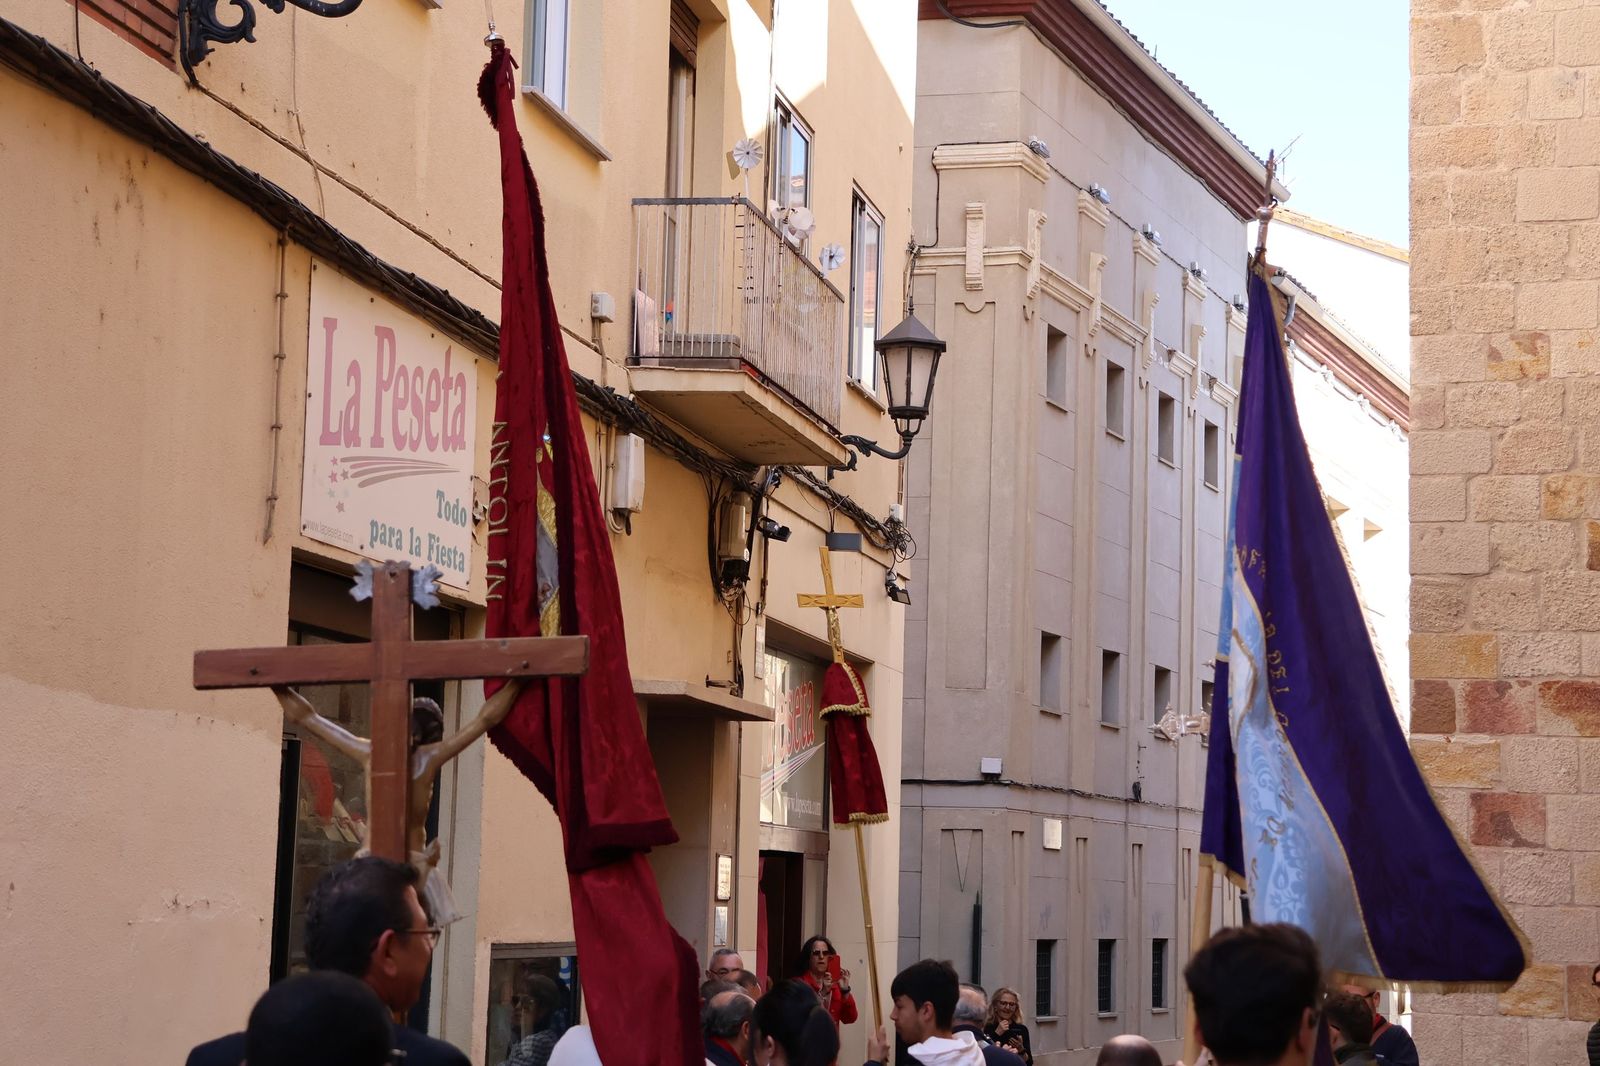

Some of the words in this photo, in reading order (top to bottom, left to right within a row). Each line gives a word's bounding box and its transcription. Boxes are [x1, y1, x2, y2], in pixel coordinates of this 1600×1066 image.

[319, 317, 361, 448] La
[370, 325, 467, 452] Peseta
[436, 489, 467, 528] Todo
[369, 517, 403, 551] para
[409, 527, 422, 557] la
[428, 532, 466, 573] Fiesta
